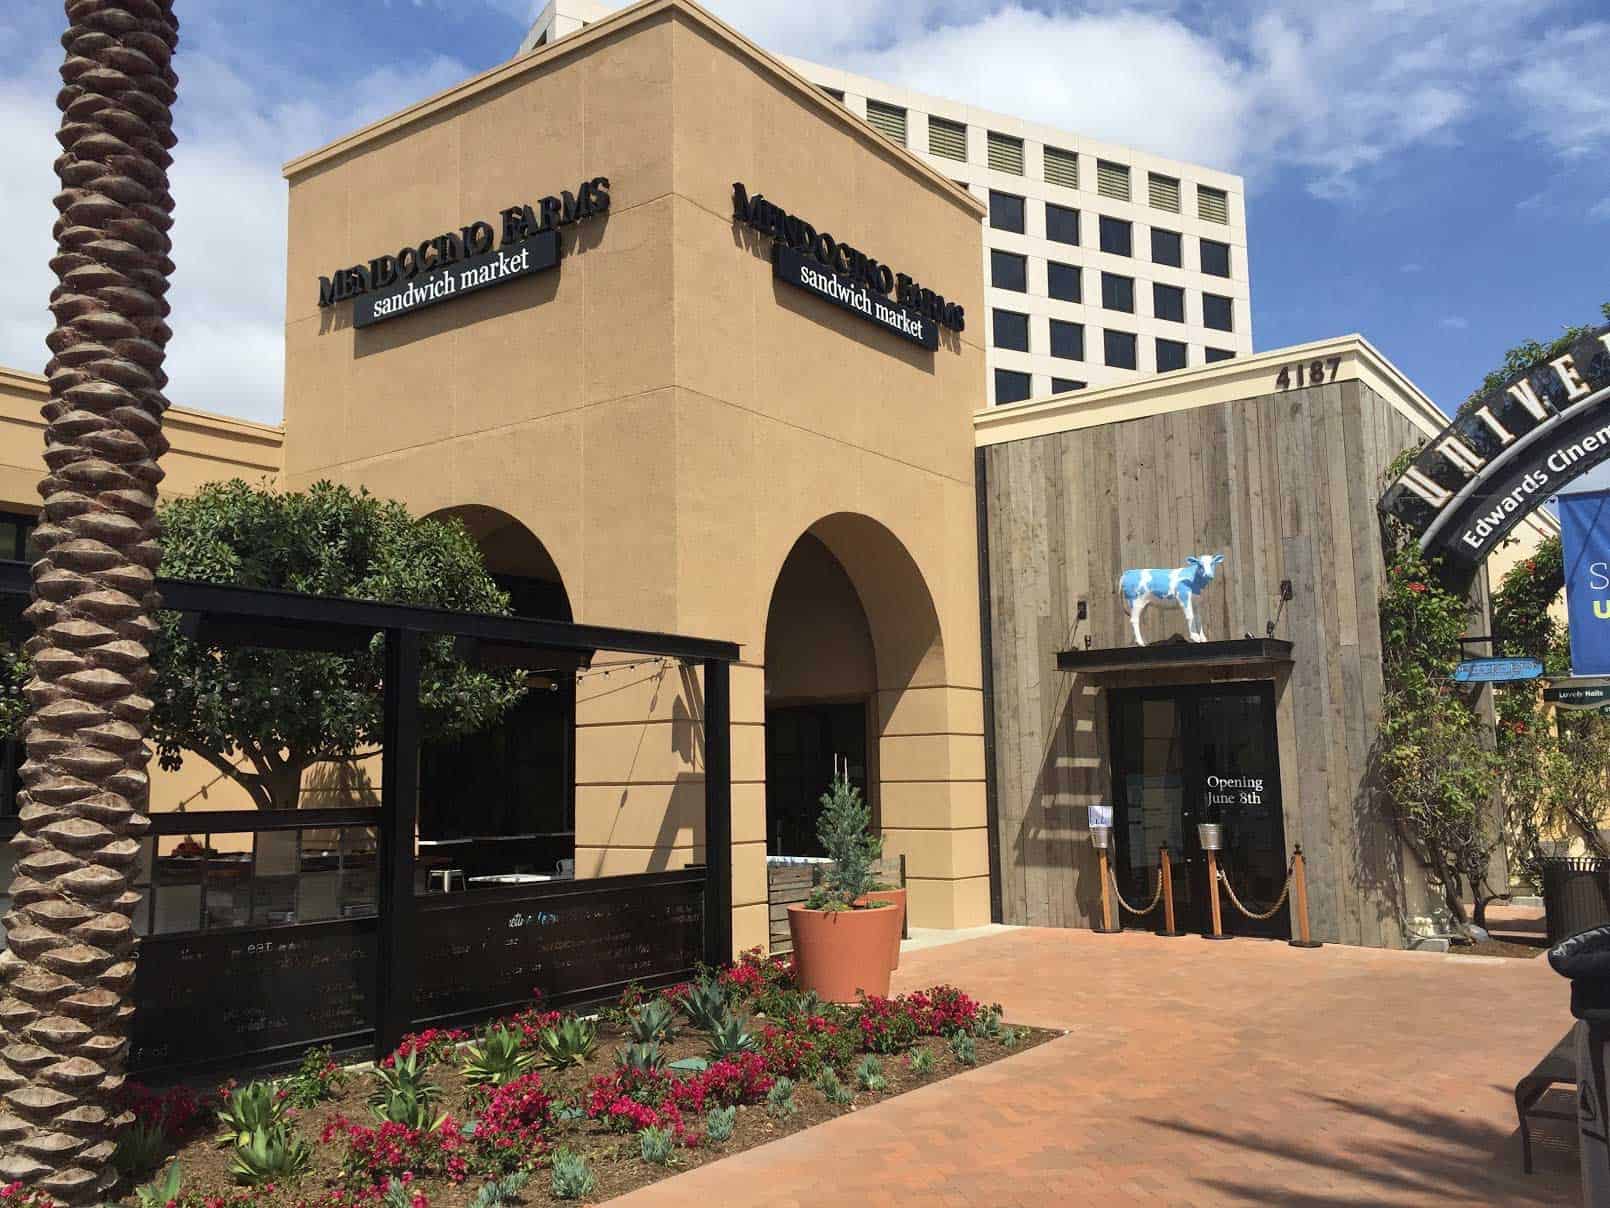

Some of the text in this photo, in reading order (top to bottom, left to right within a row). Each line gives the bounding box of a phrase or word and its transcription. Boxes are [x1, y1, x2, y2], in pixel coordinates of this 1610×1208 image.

[318, 177, 611, 307] MENDOCINO FARMS
[732, 182, 965, 333] MENDOCINO FARMS
[373, 247, 529, 318] sandwich market
[800, 265, 924, 340] sandwich market
[1275, 357, 1341, 389] 4187
[1462, 468, 1549, 549] Edwards
[1207, 775, 1264, 792] Opening
[1208, 791, 1261, 807] June 8th
